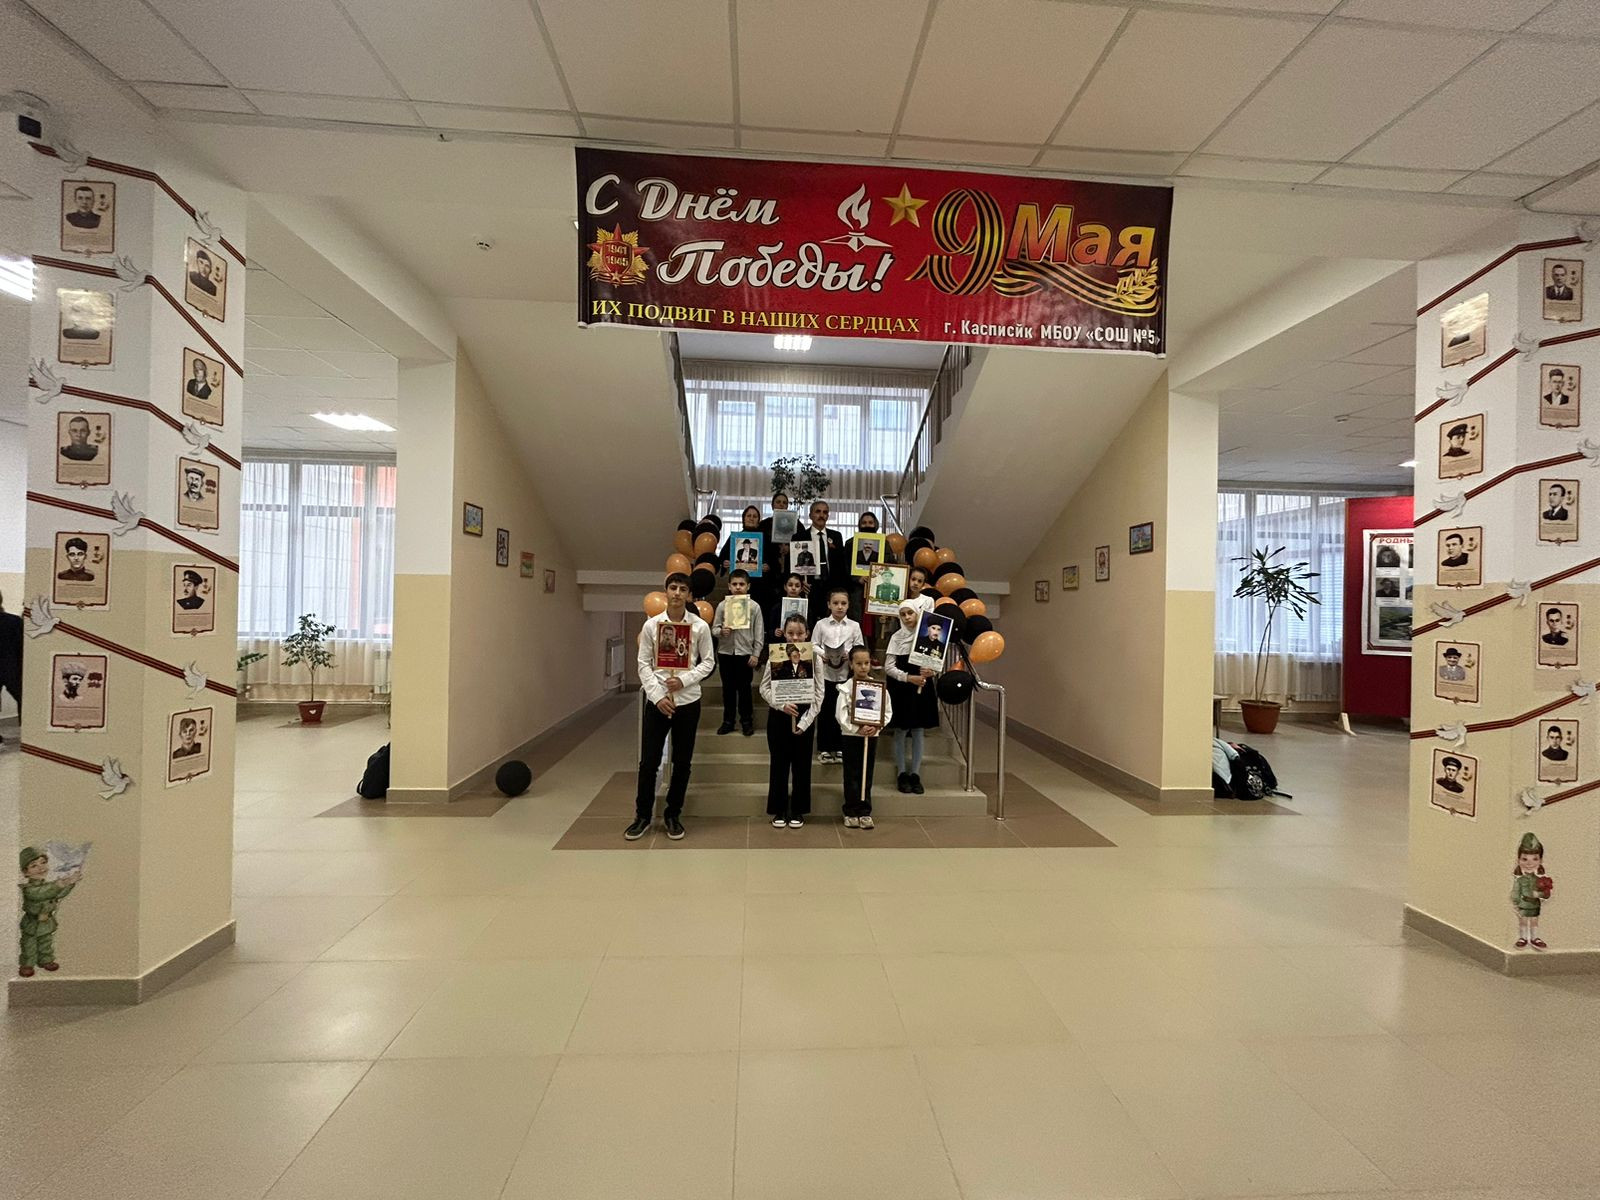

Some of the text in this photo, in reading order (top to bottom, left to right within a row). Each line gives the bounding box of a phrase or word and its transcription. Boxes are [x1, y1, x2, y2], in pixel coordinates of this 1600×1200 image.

[585, 174, 780, 225] С Днём
[605, 255, 629, 267] 1945
[907, 188, 1156, 296] 9 Мая
[656, 240, 895, 293] Победы!
[592, 299, 921, 336] ИХ ПОДВИГ В НАШИХ СЕРДЦАХ
[944, 322, 957, 336] г.
[960, 319, 1034, 341] Касписйк
[1040, 324, 1082, 341] МБОУ
[1085, 325, 1129, 344] «СОШ
